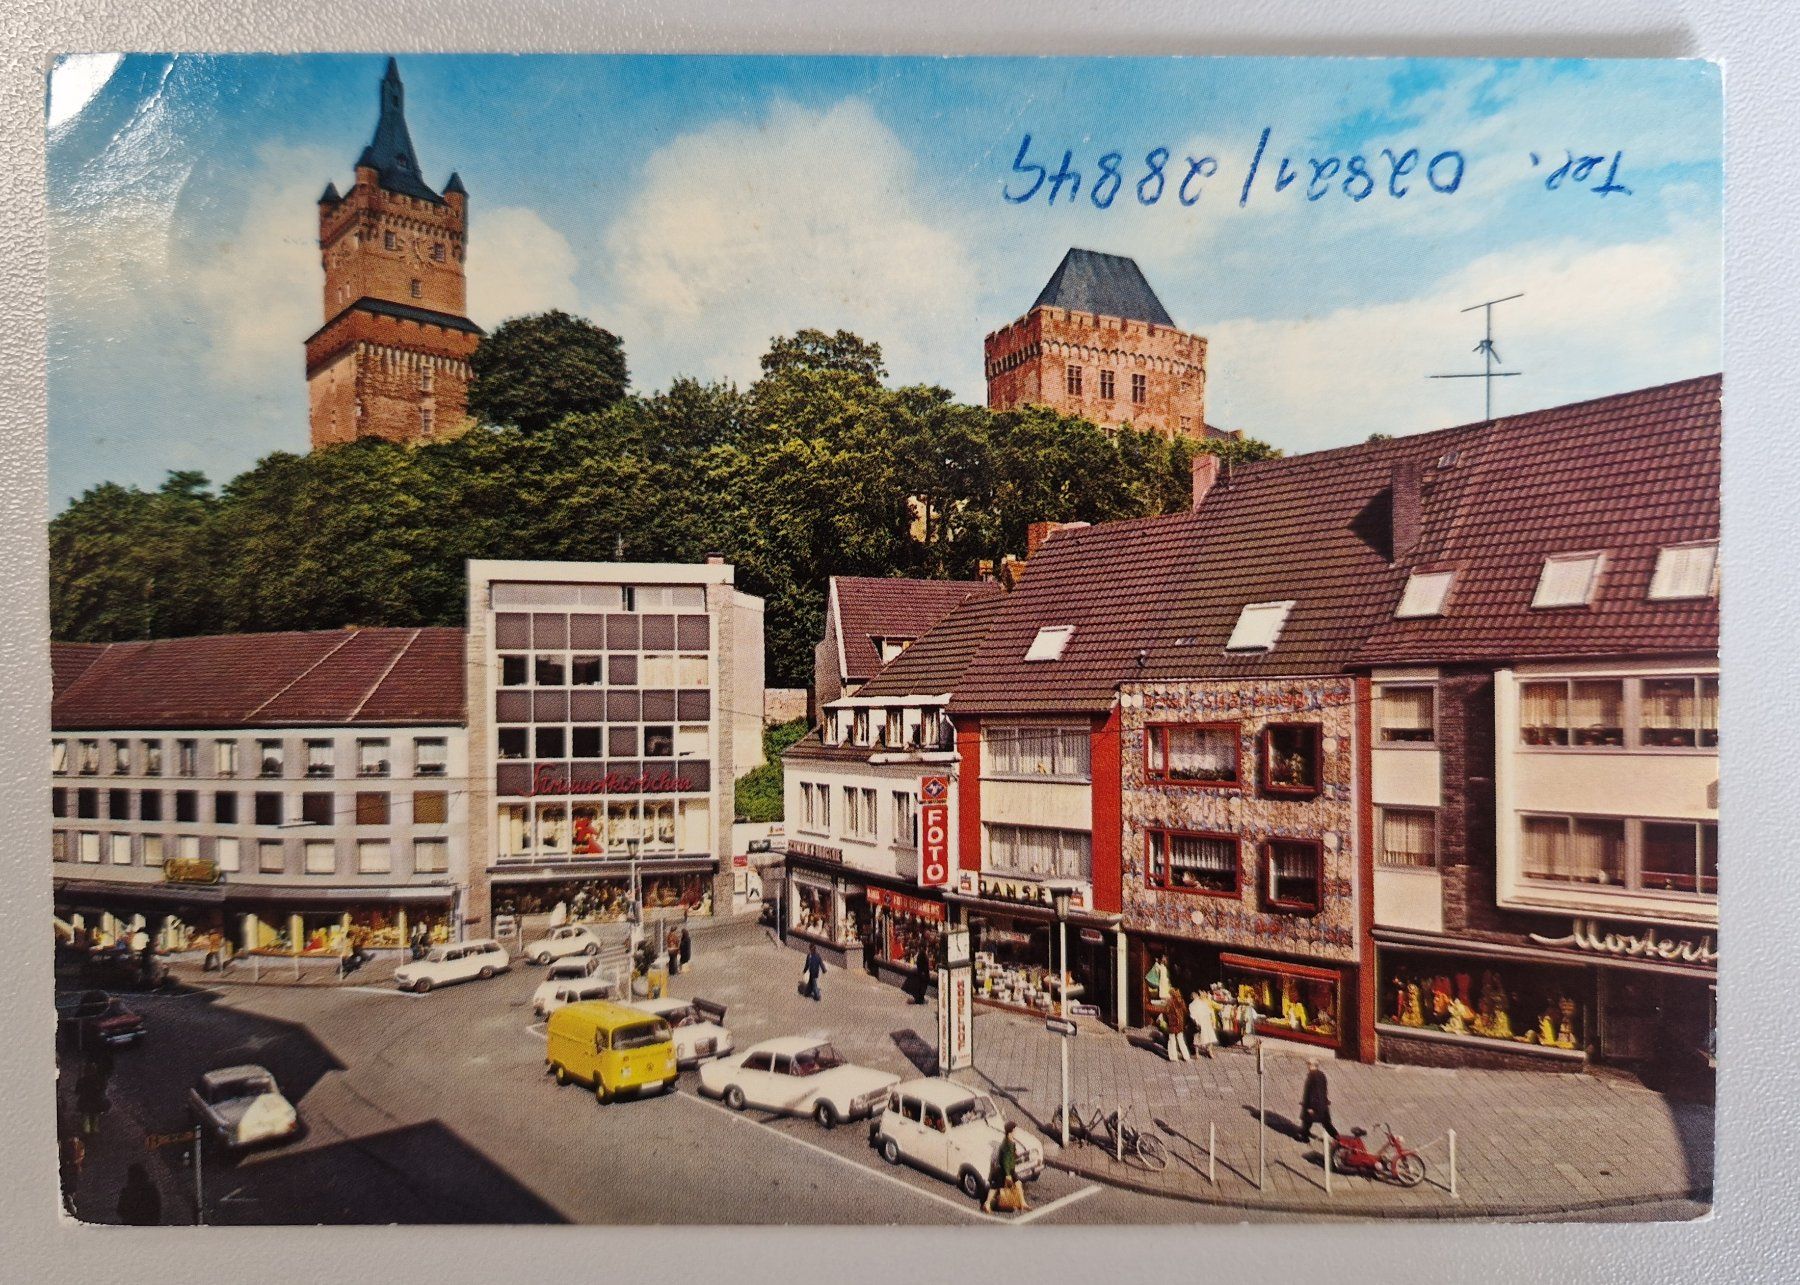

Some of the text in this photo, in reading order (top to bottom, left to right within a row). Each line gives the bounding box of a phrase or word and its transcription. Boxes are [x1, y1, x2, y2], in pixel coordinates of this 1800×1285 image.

[1004, 127, 1631, 209] Tel. 02821/28849
[926, 809, 944, 881] FOTO
[979, 879, 1047, 903] JANSE
